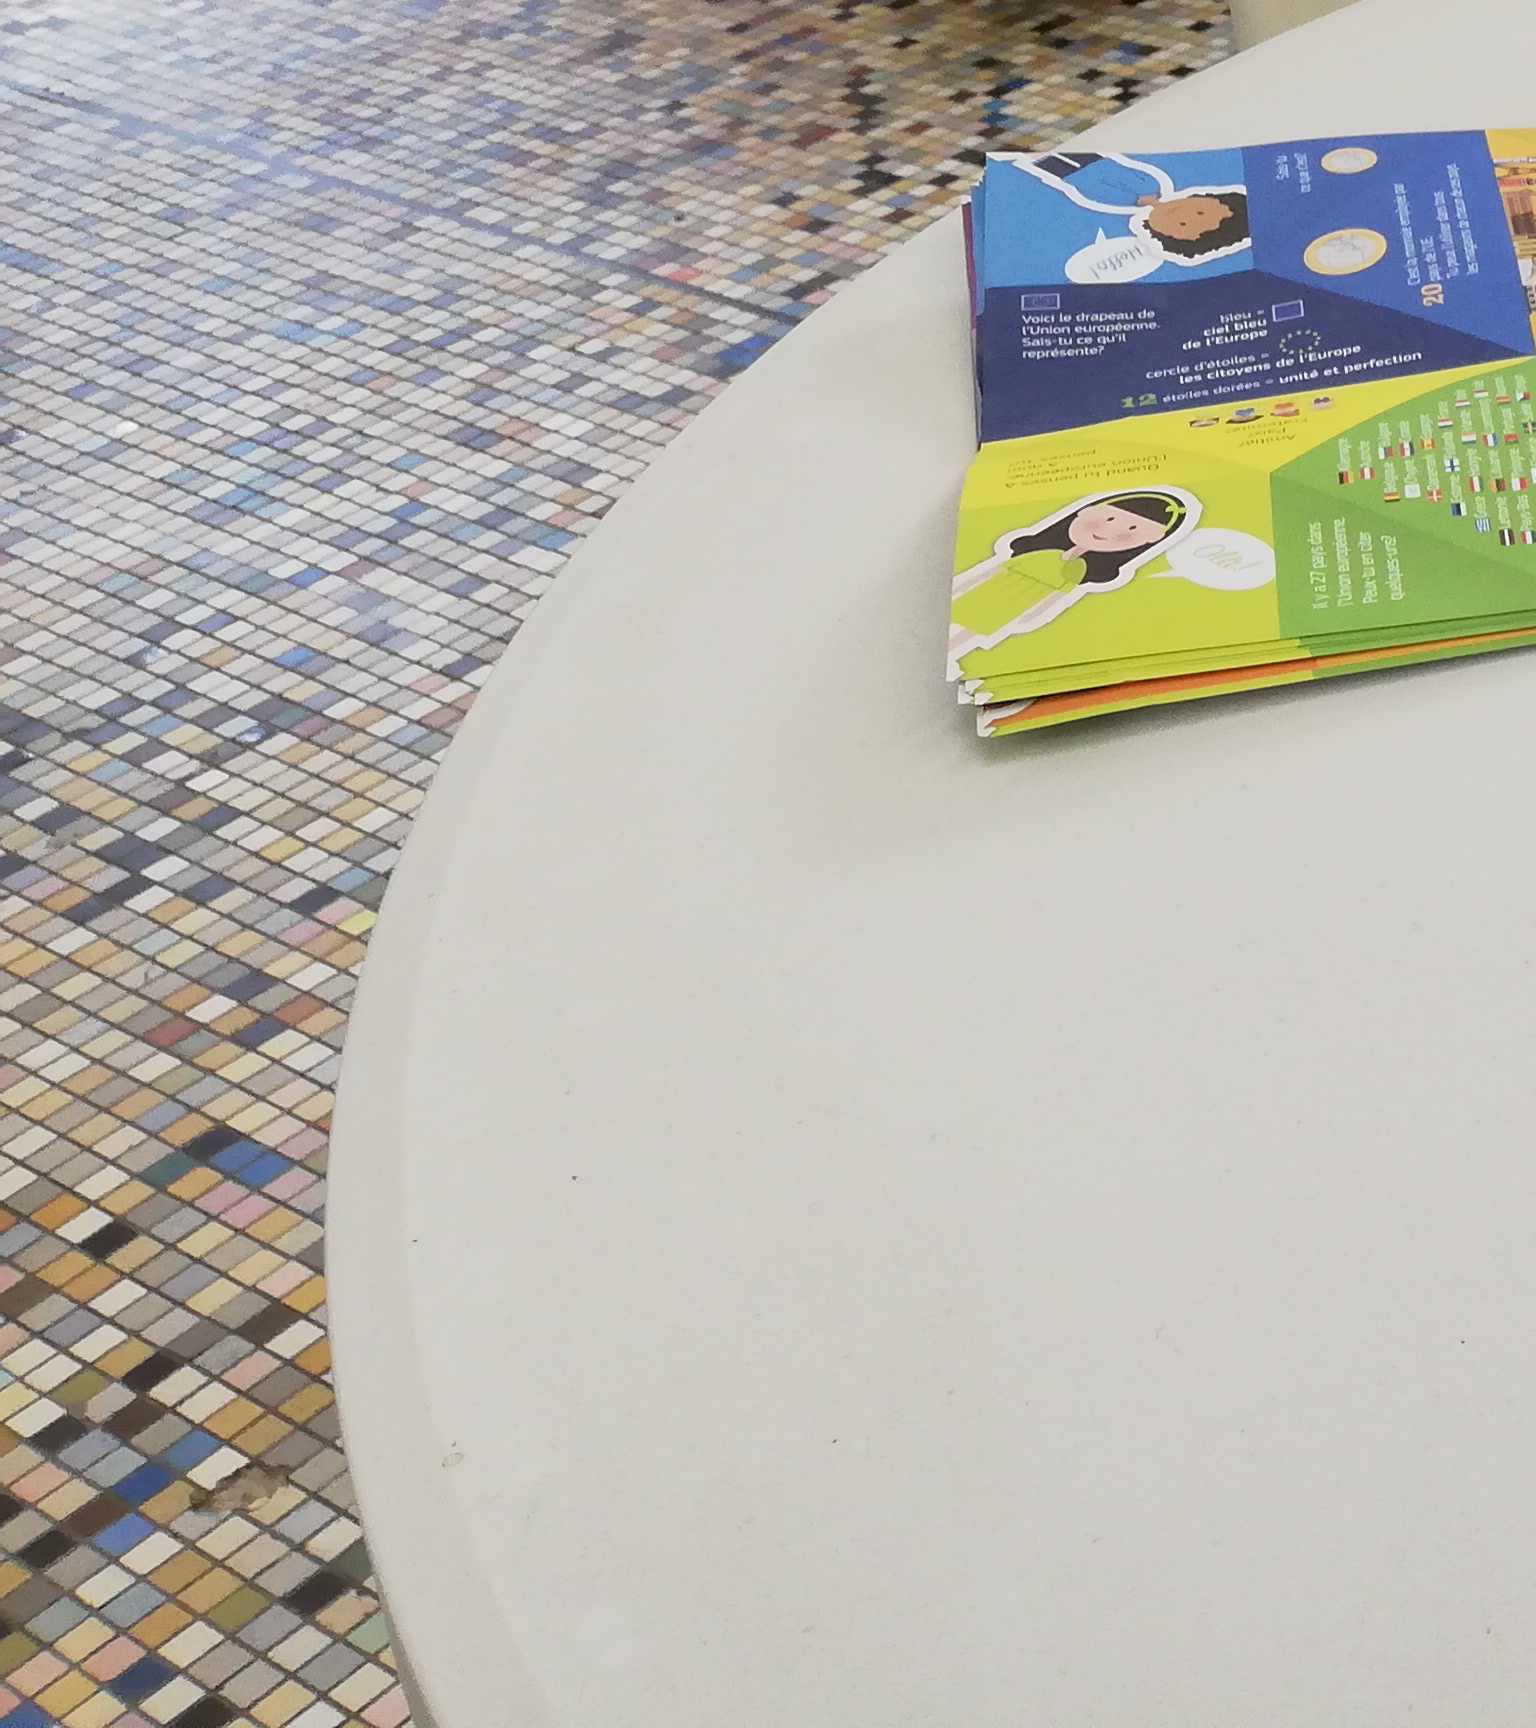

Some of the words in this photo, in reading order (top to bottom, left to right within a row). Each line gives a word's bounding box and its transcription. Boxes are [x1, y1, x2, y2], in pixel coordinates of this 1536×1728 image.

[1421, 283, 1444, 307] 20
[1022, 314, 1058, 325] Voici
[1060, 313, 1073, 323] le
[1075, 310, 1134, 325] drapeau
[1137, 308, 1156, 320] de
[1220, 312, 1251, 324] bleu
[1022, 324, 1071, 336] l'Union
[1074, 321, 1161, 337] européenne.
[1203, 325, 1231, 337] ciel
[1233, 319, 1267, 332] bleu
[1022, 335, 1071, 347] Sais-tu
[1075, 336, 1093, 345] ce
[1097, 333, 1127, 347] qu'il
[1182, 340, 1201, 351] de
[1206, 329, 1268, 348] l'Europe
[1022, 345, 1104, 360] représente?
[1145, 365, 1191, 380] cercle
[1195, 355, 1257, 373] d'étoiles
[1179, 373, 1203, 384] les
[1207, 361, 1270, 382] citoyens
[1276, 357, 1295, 368] de
[1299, 345, 1362, 365] l'Europe
[1121, 392, 1157, 409] 12
[1162, 389, 1209, 403] étoiles
[1213, 380, 1261, 396] dorées
[1278, 370, 1319, 385] unité
[1323, 368, 1340, 379] et
[1344, 350, 1422, 375] perfection
